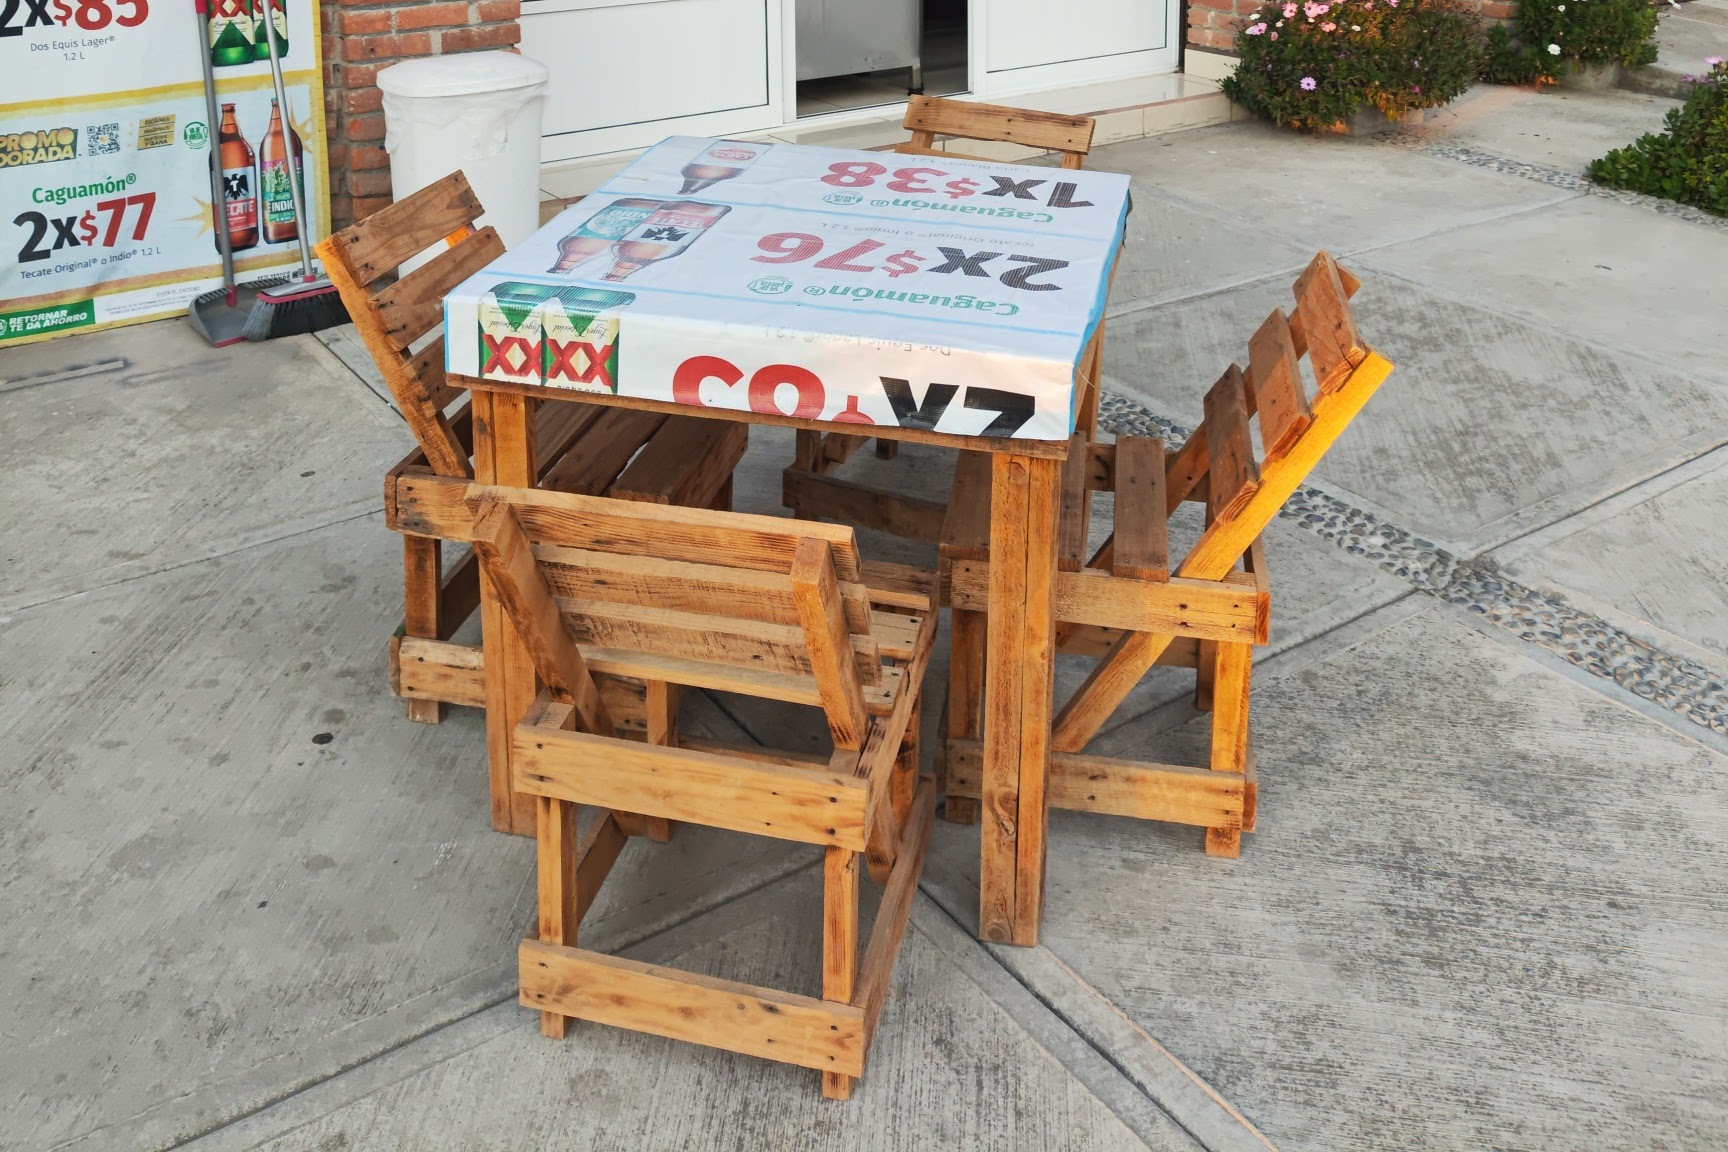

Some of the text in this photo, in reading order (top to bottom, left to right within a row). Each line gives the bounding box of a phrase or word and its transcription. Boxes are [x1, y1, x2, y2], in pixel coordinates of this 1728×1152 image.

[30, 35, 115, 52] Dos Equis Lager®
[63, 53, 76, 61] 1.2
[32, 173, 137, 205] Caguamón®
[820, 161, 1096, 208] 1x$38
[610, 210, 652, 219] NDIO
[653, 216, 704, 228] TECATE
[870, 197, 1054, 224] Caguamón®
[12, 192, 156, 264] 2x$77
[20, 268, 53, 280] Tecate
[54, 257, 98, 273] Original®
[109, 249, 137, 263] Indio®
[141, 248, 153, 257] 1.2
[156, 246, 162, 254] L
[749, 232, 1070, 291] 2x$76
[803, 284, 1020, 317] Caguamón®
[9, 310, 68, 325] RETORNAR
[10, 312, 88, 332] TE DA AHORRO
